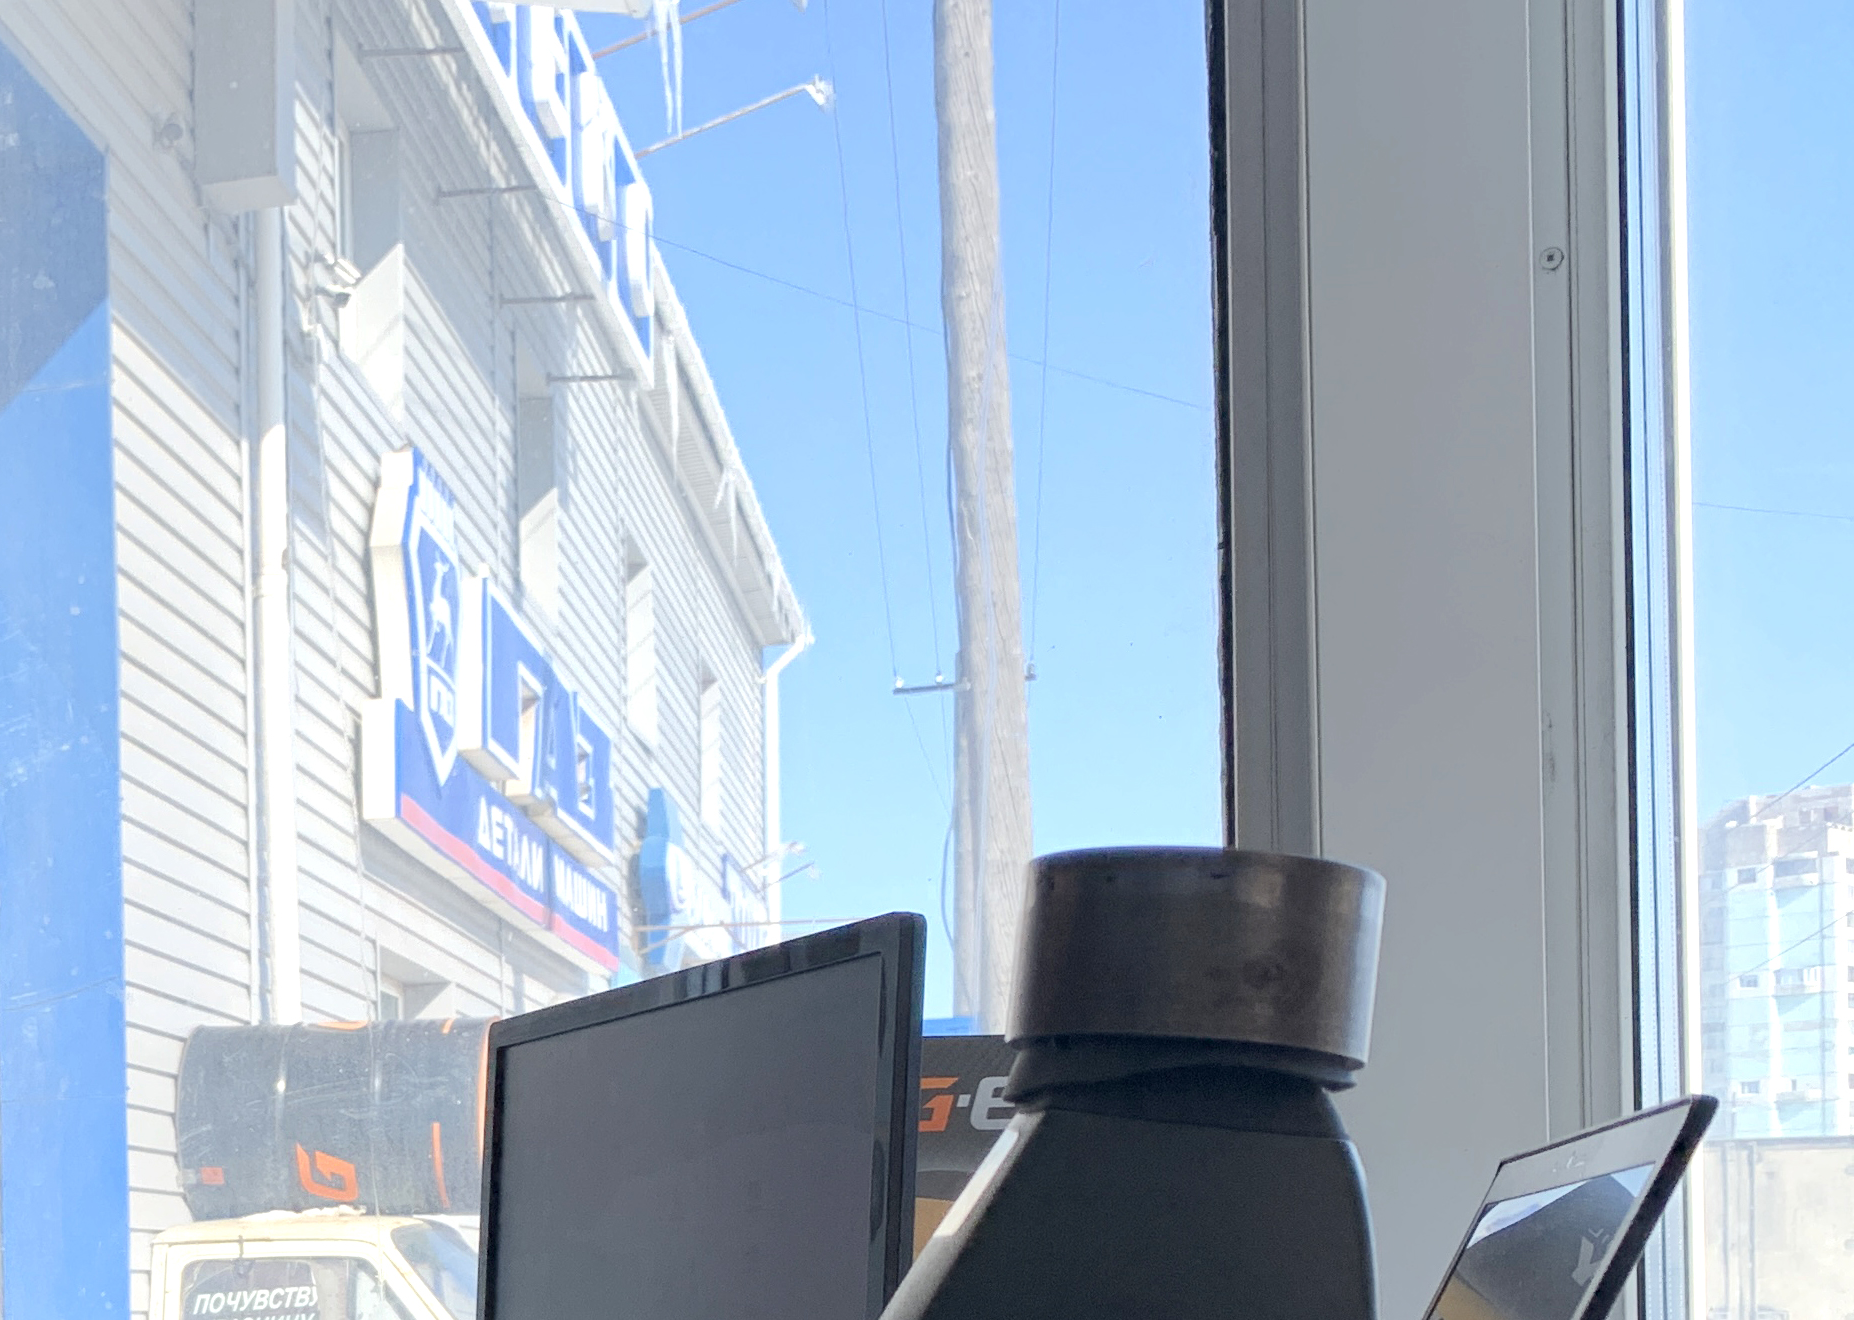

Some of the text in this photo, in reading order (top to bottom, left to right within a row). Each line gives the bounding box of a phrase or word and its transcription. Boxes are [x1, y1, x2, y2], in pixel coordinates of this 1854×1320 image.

[477, 795, 609, 933] ДЕТАЛИ МАШИН
[918, 1076, 1016, 1132] G-E
